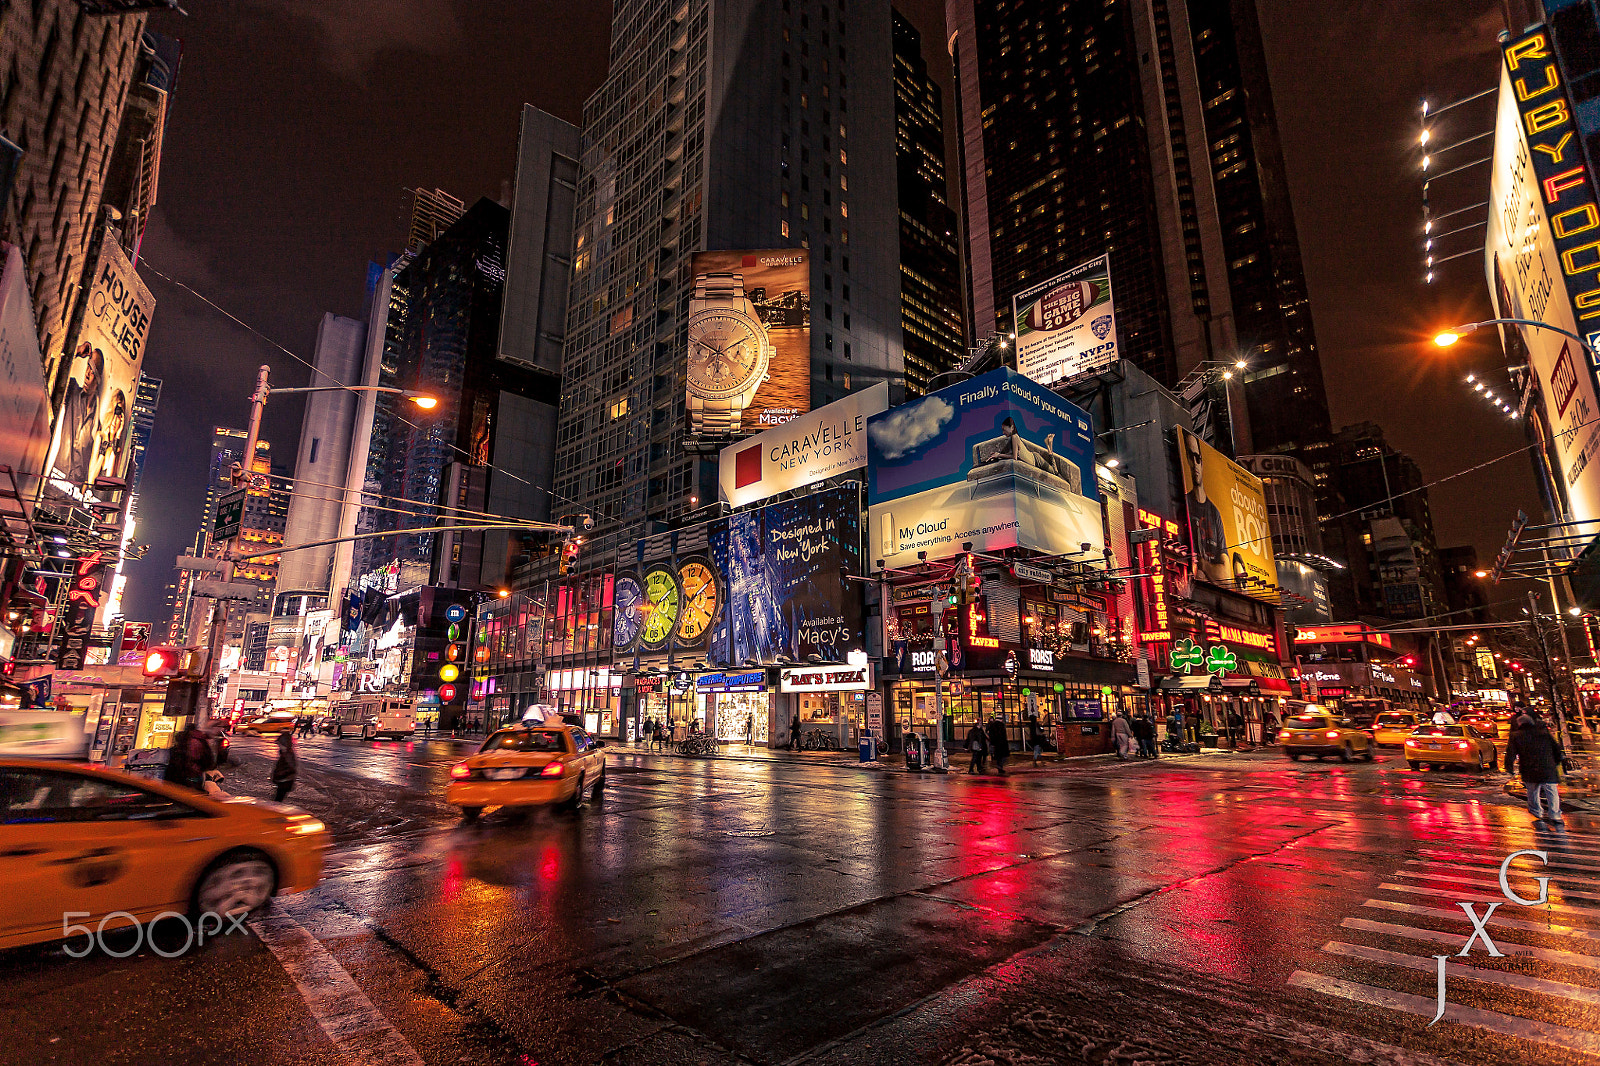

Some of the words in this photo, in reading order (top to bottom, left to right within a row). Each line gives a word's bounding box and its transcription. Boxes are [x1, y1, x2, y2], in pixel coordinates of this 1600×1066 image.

[1505, 34, 1575, 164] RUBY
[1503, 120, 1527, 248] Climbed
[760, 254, 802, 264] CARAVELLE
[1018, 283, 1048, 300] Welcome
[1056, 273, 1072, 283] New
[1071, 266, 1088, 277] York
[1088, 259, 1104, 268] City
[100, 262, 149, 338] HOUSE
[1043, 299, 1059, 311] THE
[1058, 291, 1080, 306] BIG
[1528, 249, 1553, 336] Blind.
[92, 290, 116, 322] OF
[1043, 298, 1081, 320] GAME
[1045, 307, 1082, 330] 2014
[111, 313, 141, 361] LIES
[1079, 341, 1115, 359] NYPD
[1552, 349, 1576, 411] VISION
[960, 385, 999, 406] Finally,
[1002, 381, 1010, 391] a
[1011, 383, 1032, 402] cloud
[1032, 395, 1041, 406] of
[1041, 400, 1056, 414] your
[763, 407, 791, 415] Available
[770, 414, 863, 462] CARAVELLE
[780, 453, 809, 471] NEW
[813, 437, 852, 459] YORK
[1230, 482, 1258, 516] about
[1258, 504, 1266, 520] a
[770, 518, 823, 543] Designed
[825, 517, 836, 531] in
[899, 527, 914, 540] My
[916, 518, 947, 535] Cloud
[899, 542, 916, 551] Save
[916, 534, 953, 547] everything.
[954, 530, 981, 540] Access
[982, 520, 1020, 535] anywhere.
[1232, 505, 1269, 561] BOY
[776, 544, 799, 561] New
[801, 535, 830, 562] York
[652, 575, 661, 585] 12
[687, 568, 696, 577] 12
[1148, 539, 1168, 630] PLAYWRIGHT
[684, 625, 695, 634] 06
[802, 615, 835, 627] Available
[836, 615, 845, 625] at
[798, 626, 850, 646] Macy's
[969, 636, 999, 648] TAVERN
[1140, 631, 1172, 642] TAVERN
[1219, 625, 1243, 644] MAMA
[1295, 629, 1317, 640] bs
[1030, 648, 1054, 665] ROAST
[725, 672, 763, 686] COMPUTERS
[791, 673, 824, 685] RAY'S
[825, 670, 866, 684] PIZZA
[1315, 671, 1341, 680] Bene
